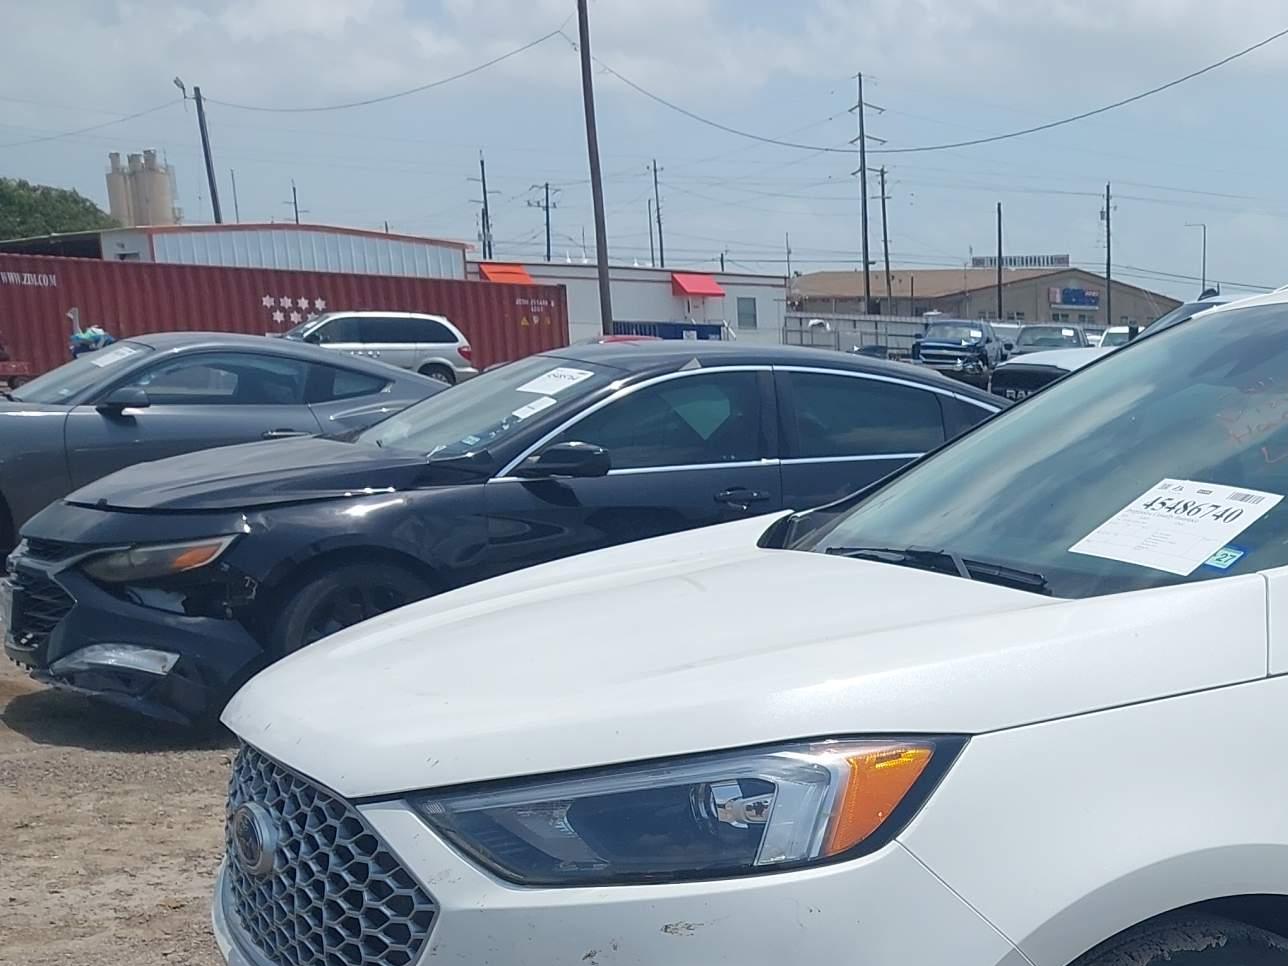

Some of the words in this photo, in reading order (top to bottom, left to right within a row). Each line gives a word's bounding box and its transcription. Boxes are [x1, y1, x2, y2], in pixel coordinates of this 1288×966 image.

[1006, 390, 1034, 400] RA
[1143, 496, 1244, 524] 45486740
[1216, 553, 1236, 564] 27
